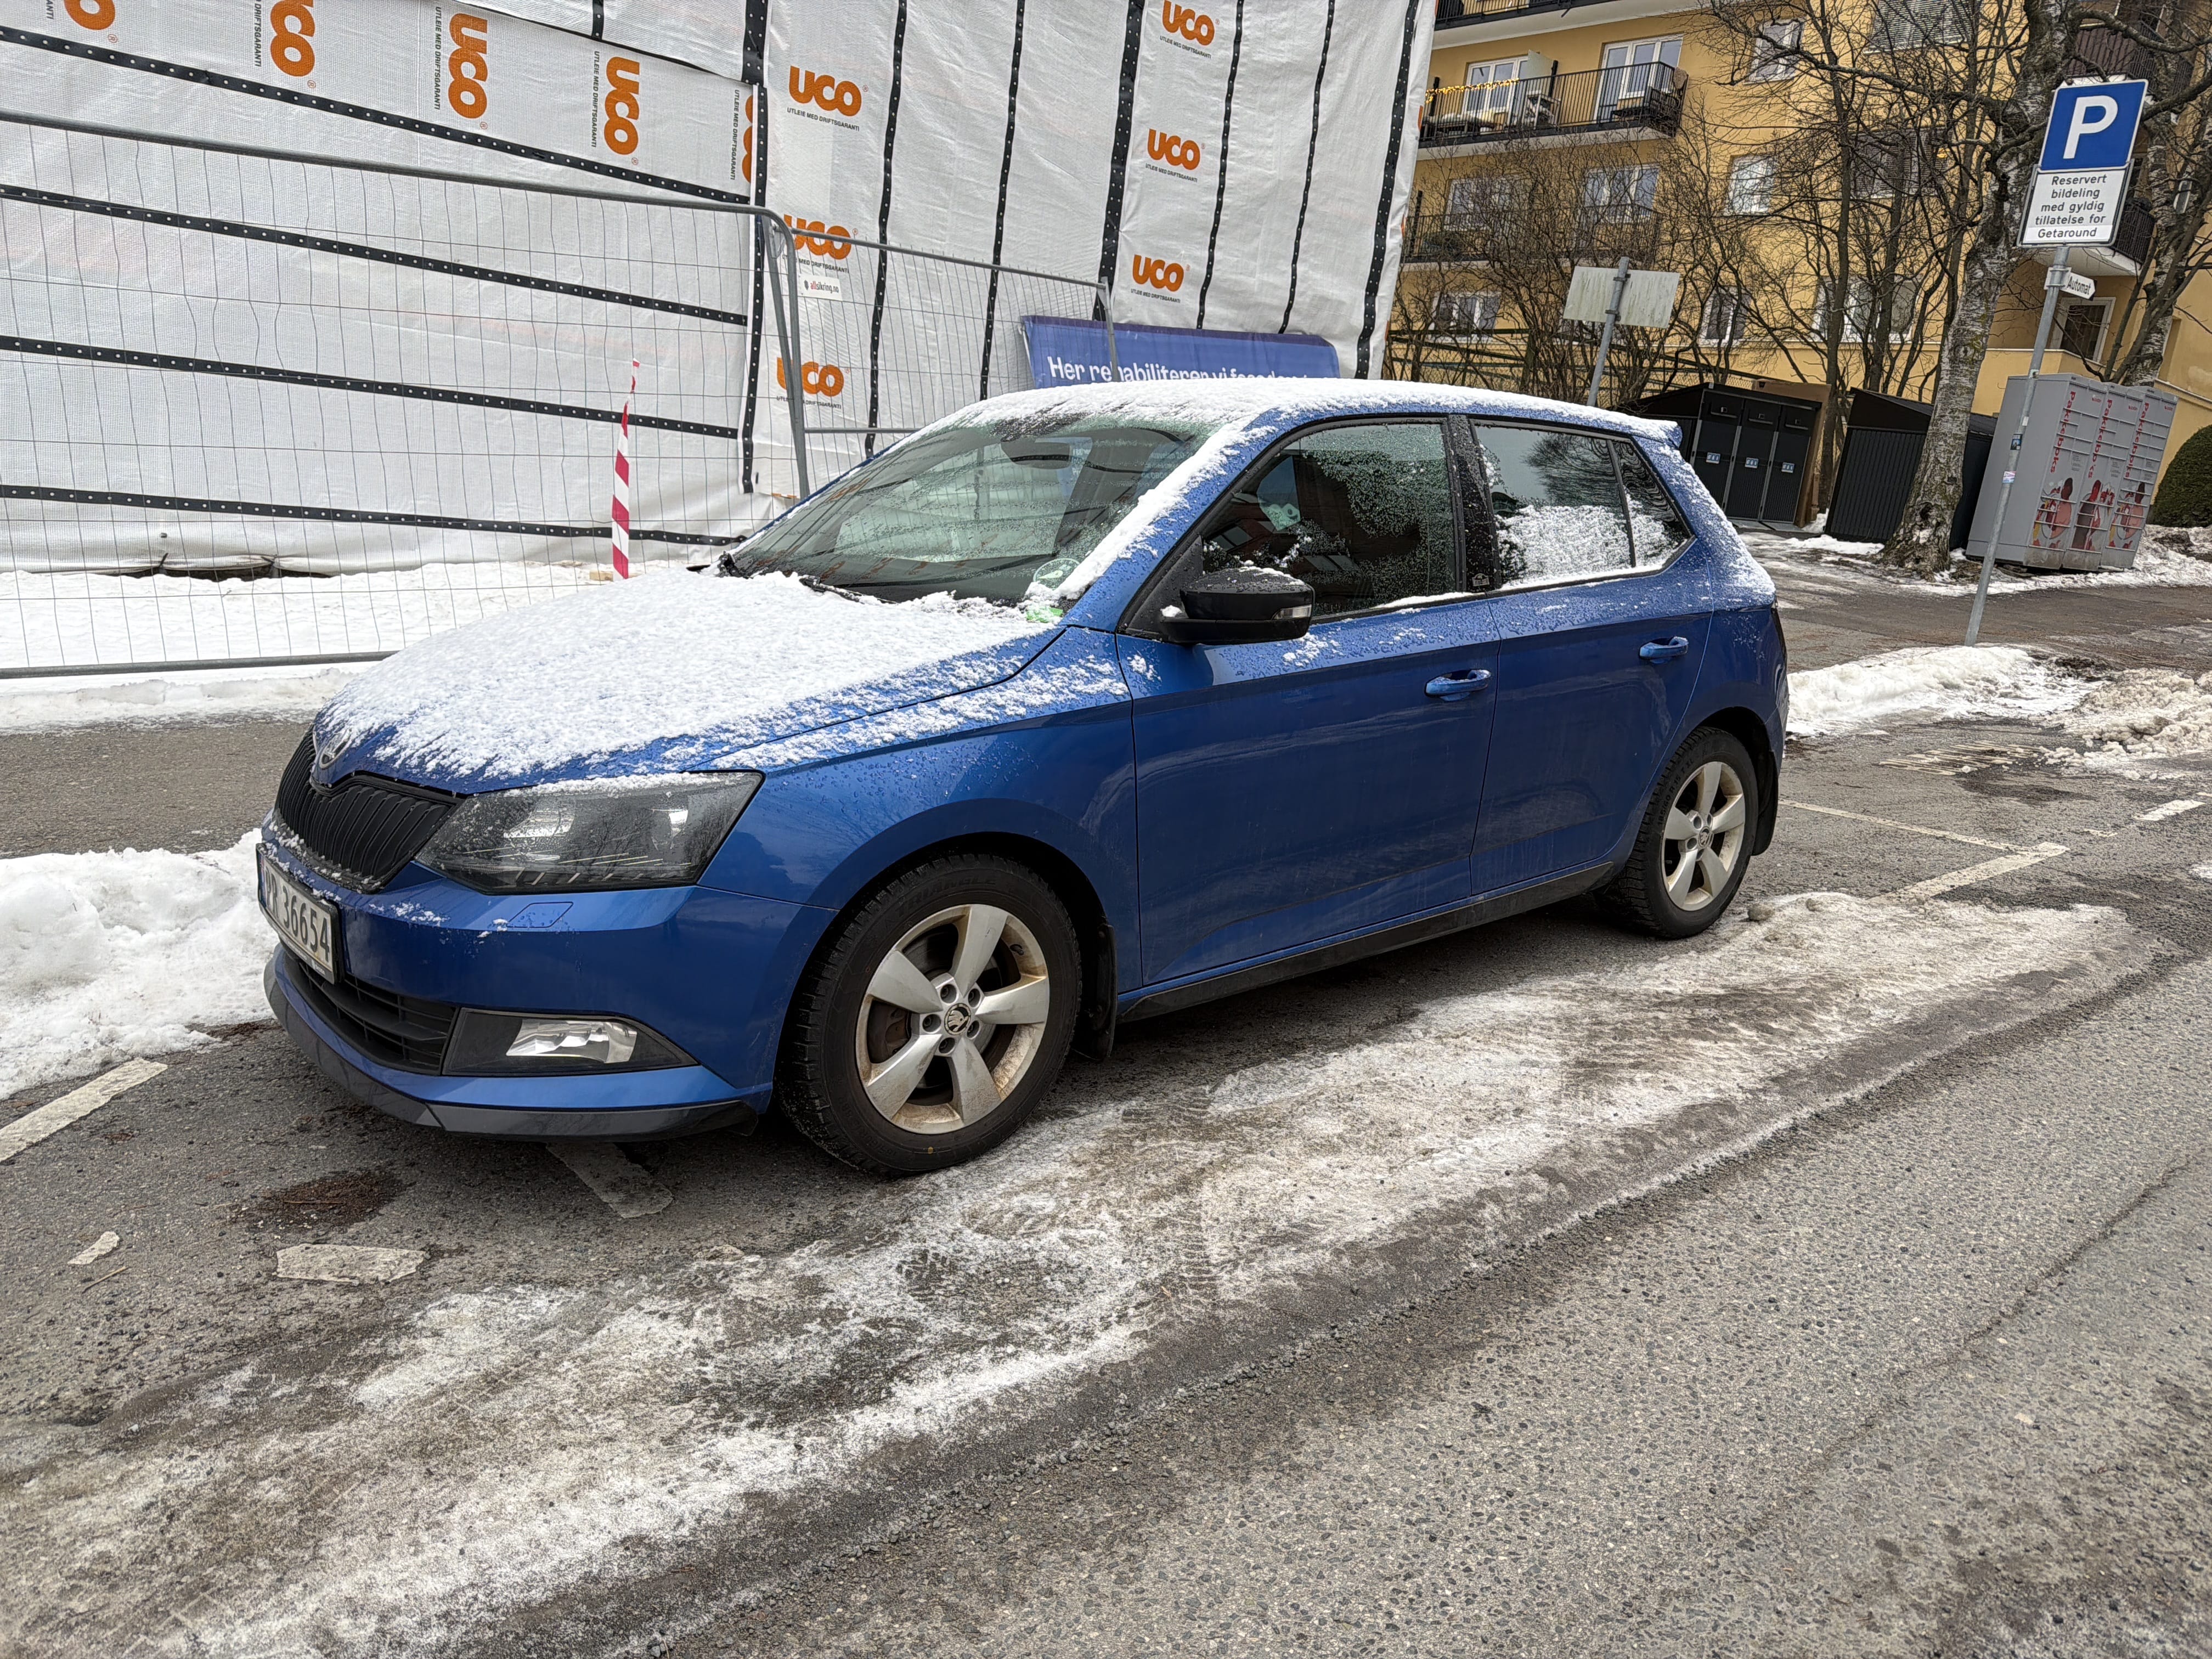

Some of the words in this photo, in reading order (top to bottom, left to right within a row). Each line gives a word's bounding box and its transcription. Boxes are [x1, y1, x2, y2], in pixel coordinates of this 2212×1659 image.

[1163, 0, 1215, 46] UCO
[270, 0, 315, 76] CO
[1160, 35, 1173, 44] UTLEIE
[1182, 44, 1211, 59] DRIFTSGARANTI
[448, 13, 488, 119] UCO
[789, 65, 861, 116] UCO
[604, 57, 640, 155] UCO
[787, 107, 806, 117] UTLEIE
[819, 116, 860, 132] DRIFTSGARANTI
[2063, 95, 2118, 159] P
[1148, 128, 1200, 170] UCO
[1146, 163, 1158, 171] UTLEIE
[1167, 171, 1198, 183] DRIFTSGARANTI
[2052, 174, 2107, 185] Reservert
[2051, 188, 2100, 199] bildeling
[2041, 202, 2064, 212] med
[2069, 200, 2104, 213] gyldig
[2035, 215, 2084, 225] tillatelse
[2089, 214, 2106, 224] for
[2038, 227, 2097, 238] Getaround
[811, 262, 849, 273] DRIFTSGARANTI
[1132, 255, 1184, 292] UCO
[810, 280, 839, 294] allsikring.no
[2067, 275, 2091, 295] Automat
[1151, 294, 1181, 303] DRIFTSGARANTI
[1047, 356, 1085, 381] Her
[283, 885, 330, 963] 36654
